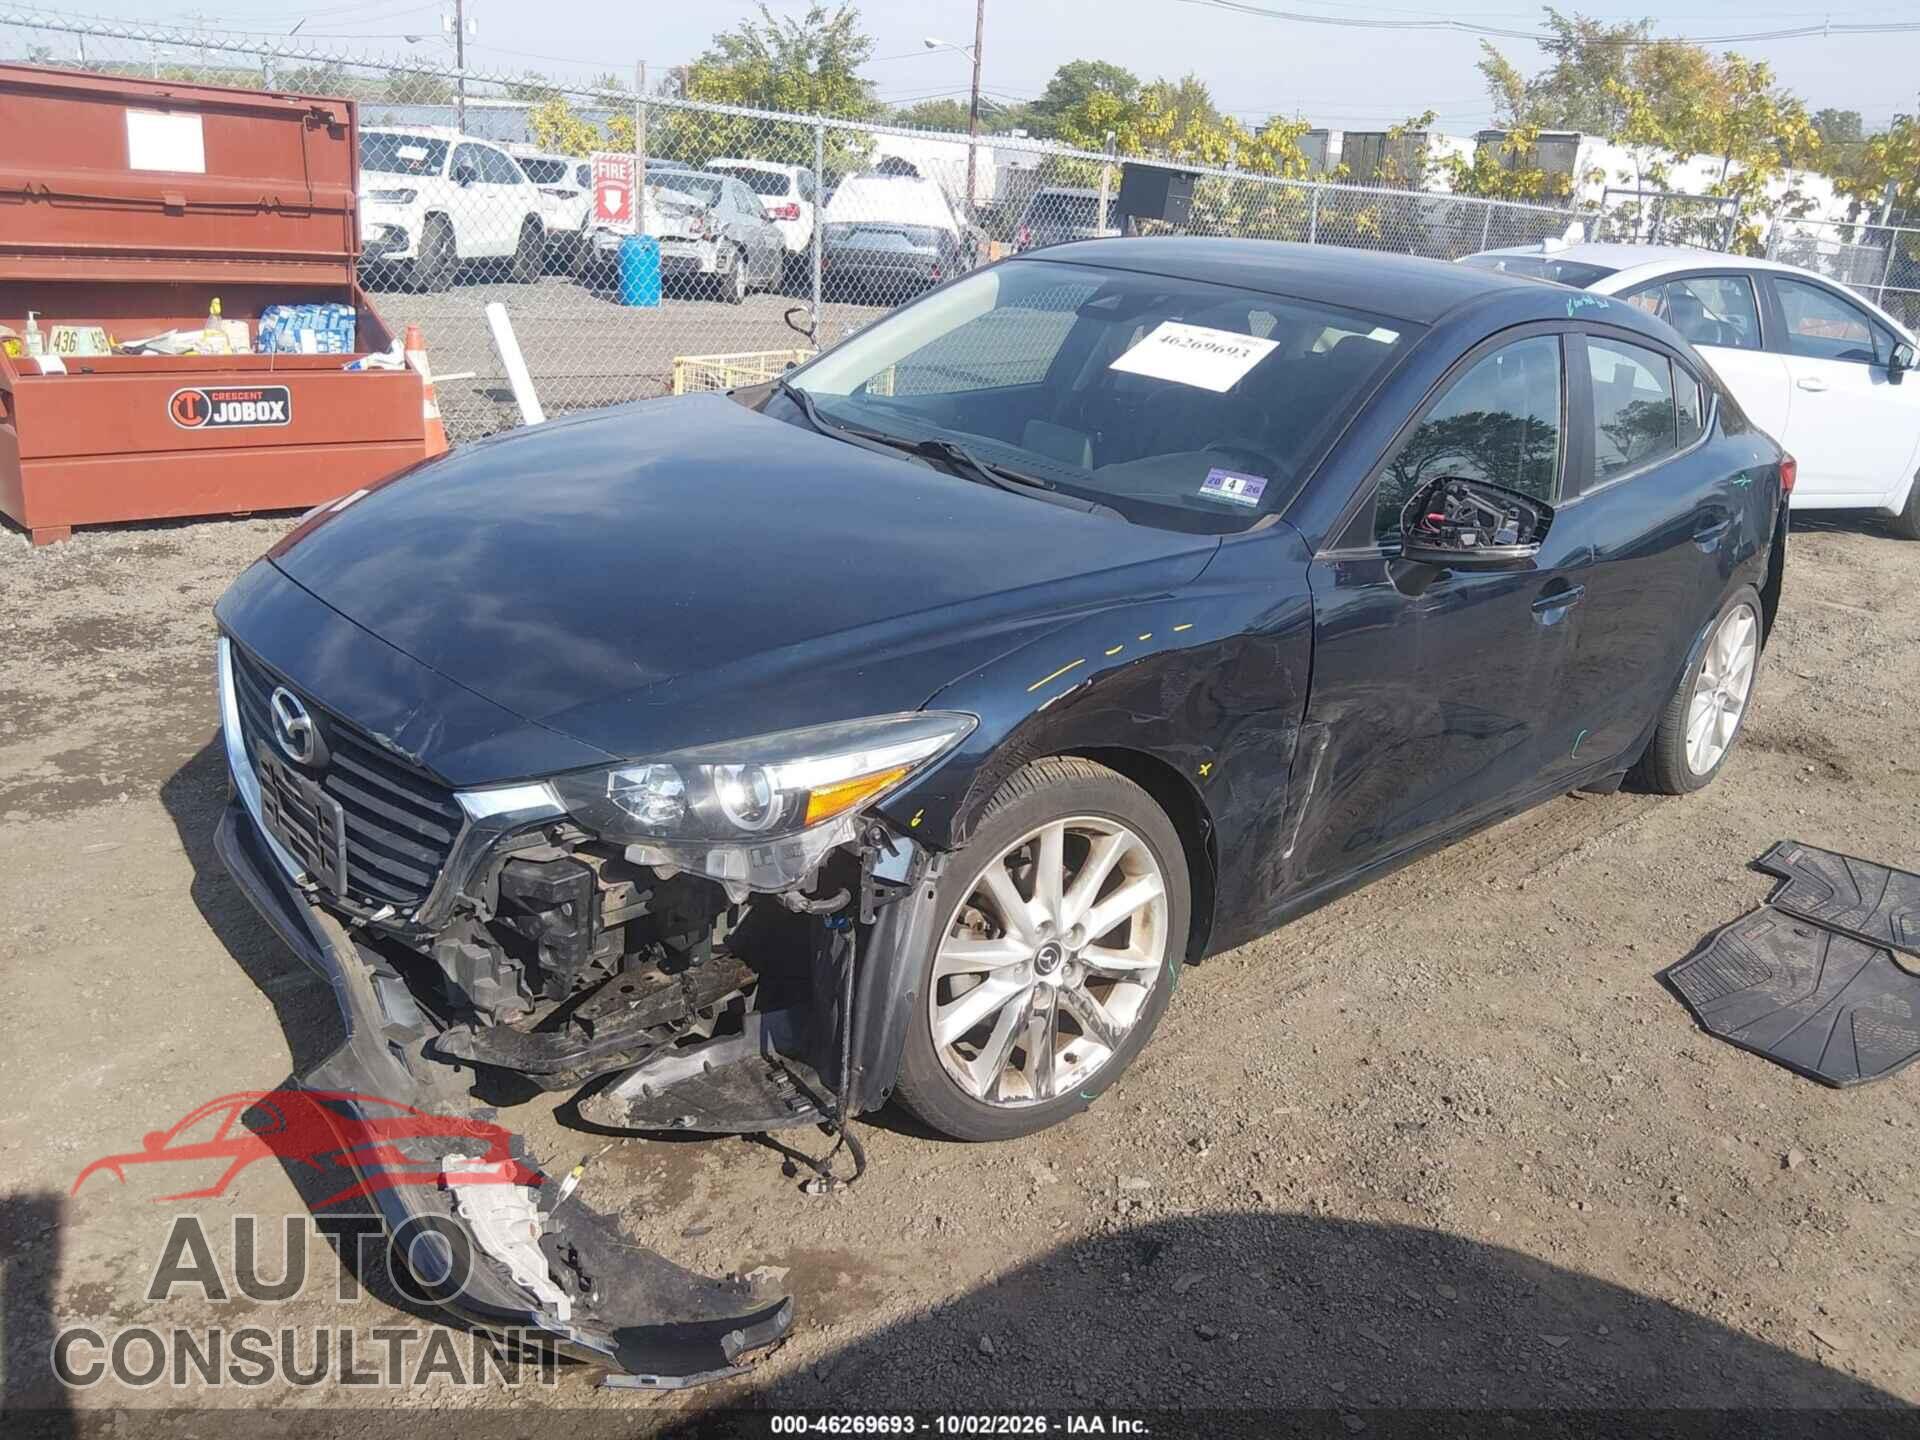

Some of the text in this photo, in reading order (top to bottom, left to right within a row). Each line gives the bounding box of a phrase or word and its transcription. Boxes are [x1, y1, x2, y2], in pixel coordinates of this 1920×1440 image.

[599, 163, 627, 179] FIRE
[54, 331, 77, 352] 436
[211, 392, 263, 401] CRESCENT
[213, 401, 286, 423] JOBOX
[1228, 479, 1238, 490] 4
